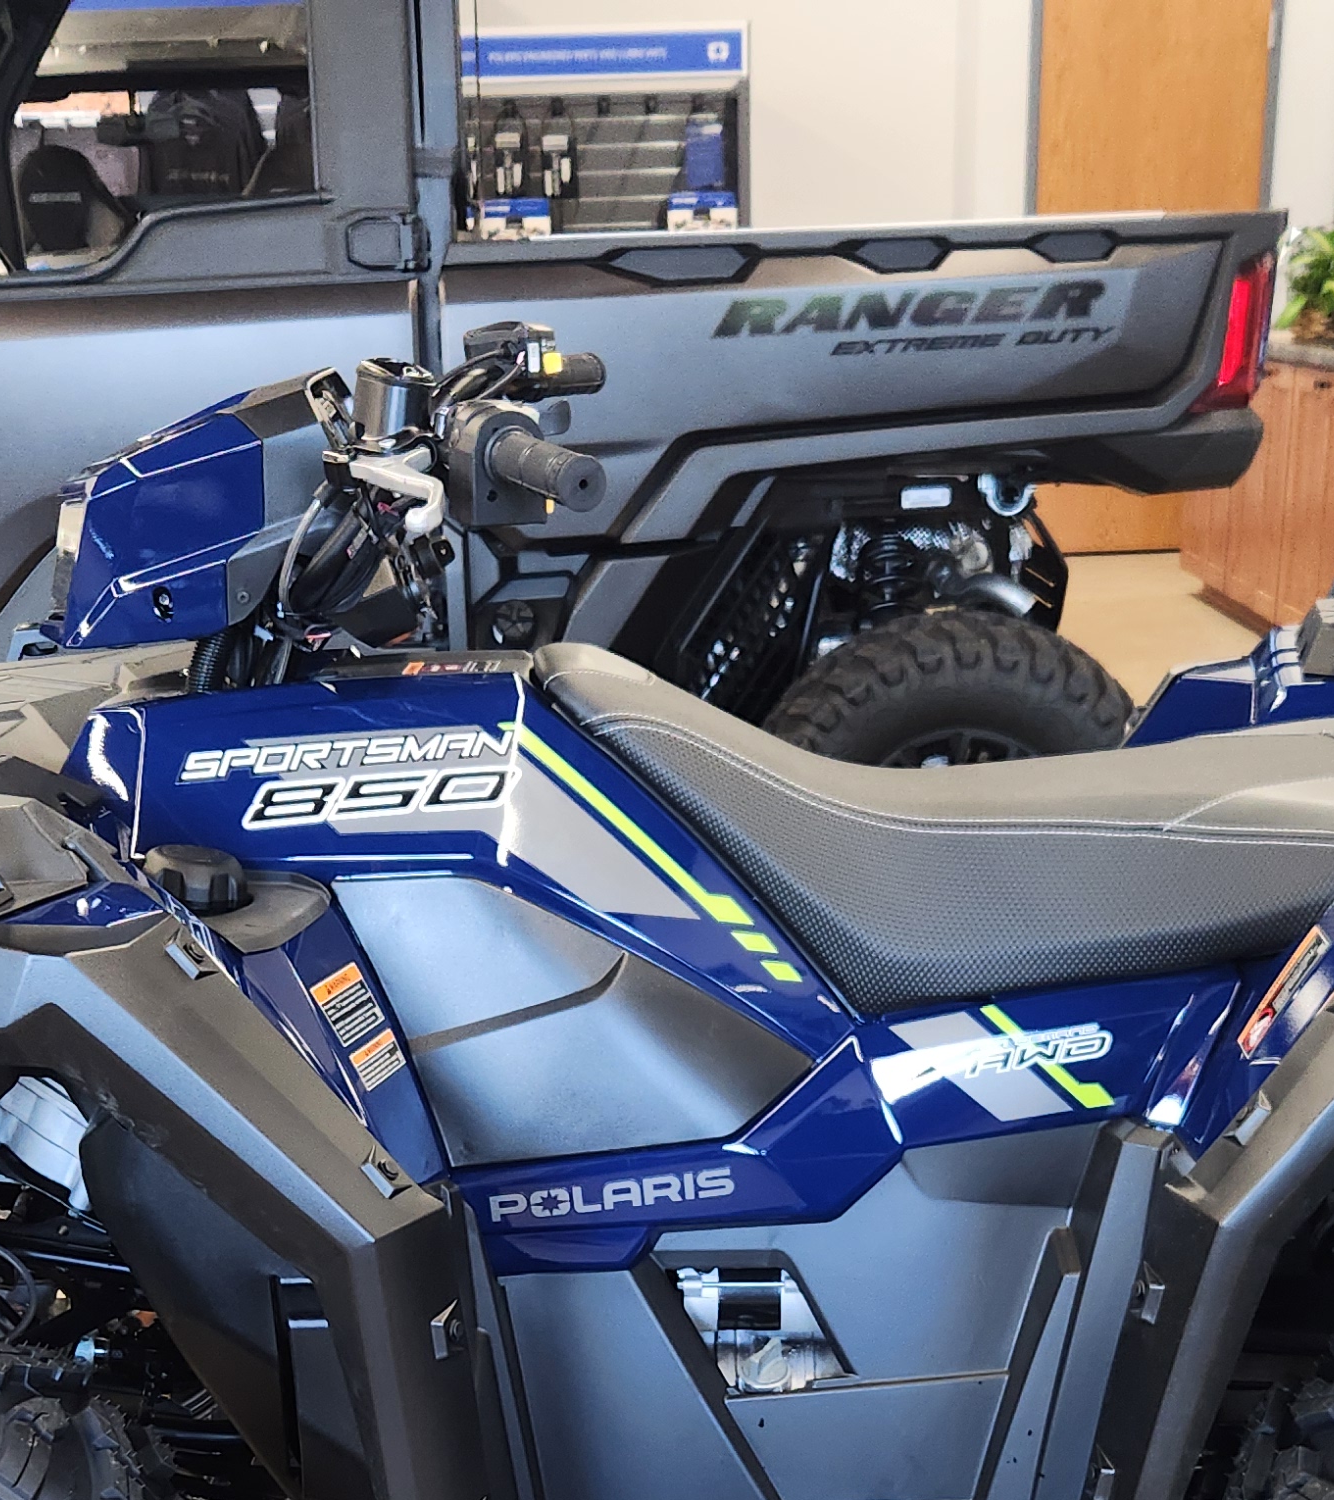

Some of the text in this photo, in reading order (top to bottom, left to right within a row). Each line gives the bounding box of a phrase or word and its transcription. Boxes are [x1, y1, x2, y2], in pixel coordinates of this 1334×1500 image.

[711, 278, 1107, 339] RANGER
[830, 326, 1116, 356] EXTREME DUTY
[178, 731, 515, 783] SPORTSMAN
[241, 765, 523, 831] 850
[963, 1030, 1114, 1079] AWD
[488, 1165, 736, 1223] POLARIS
